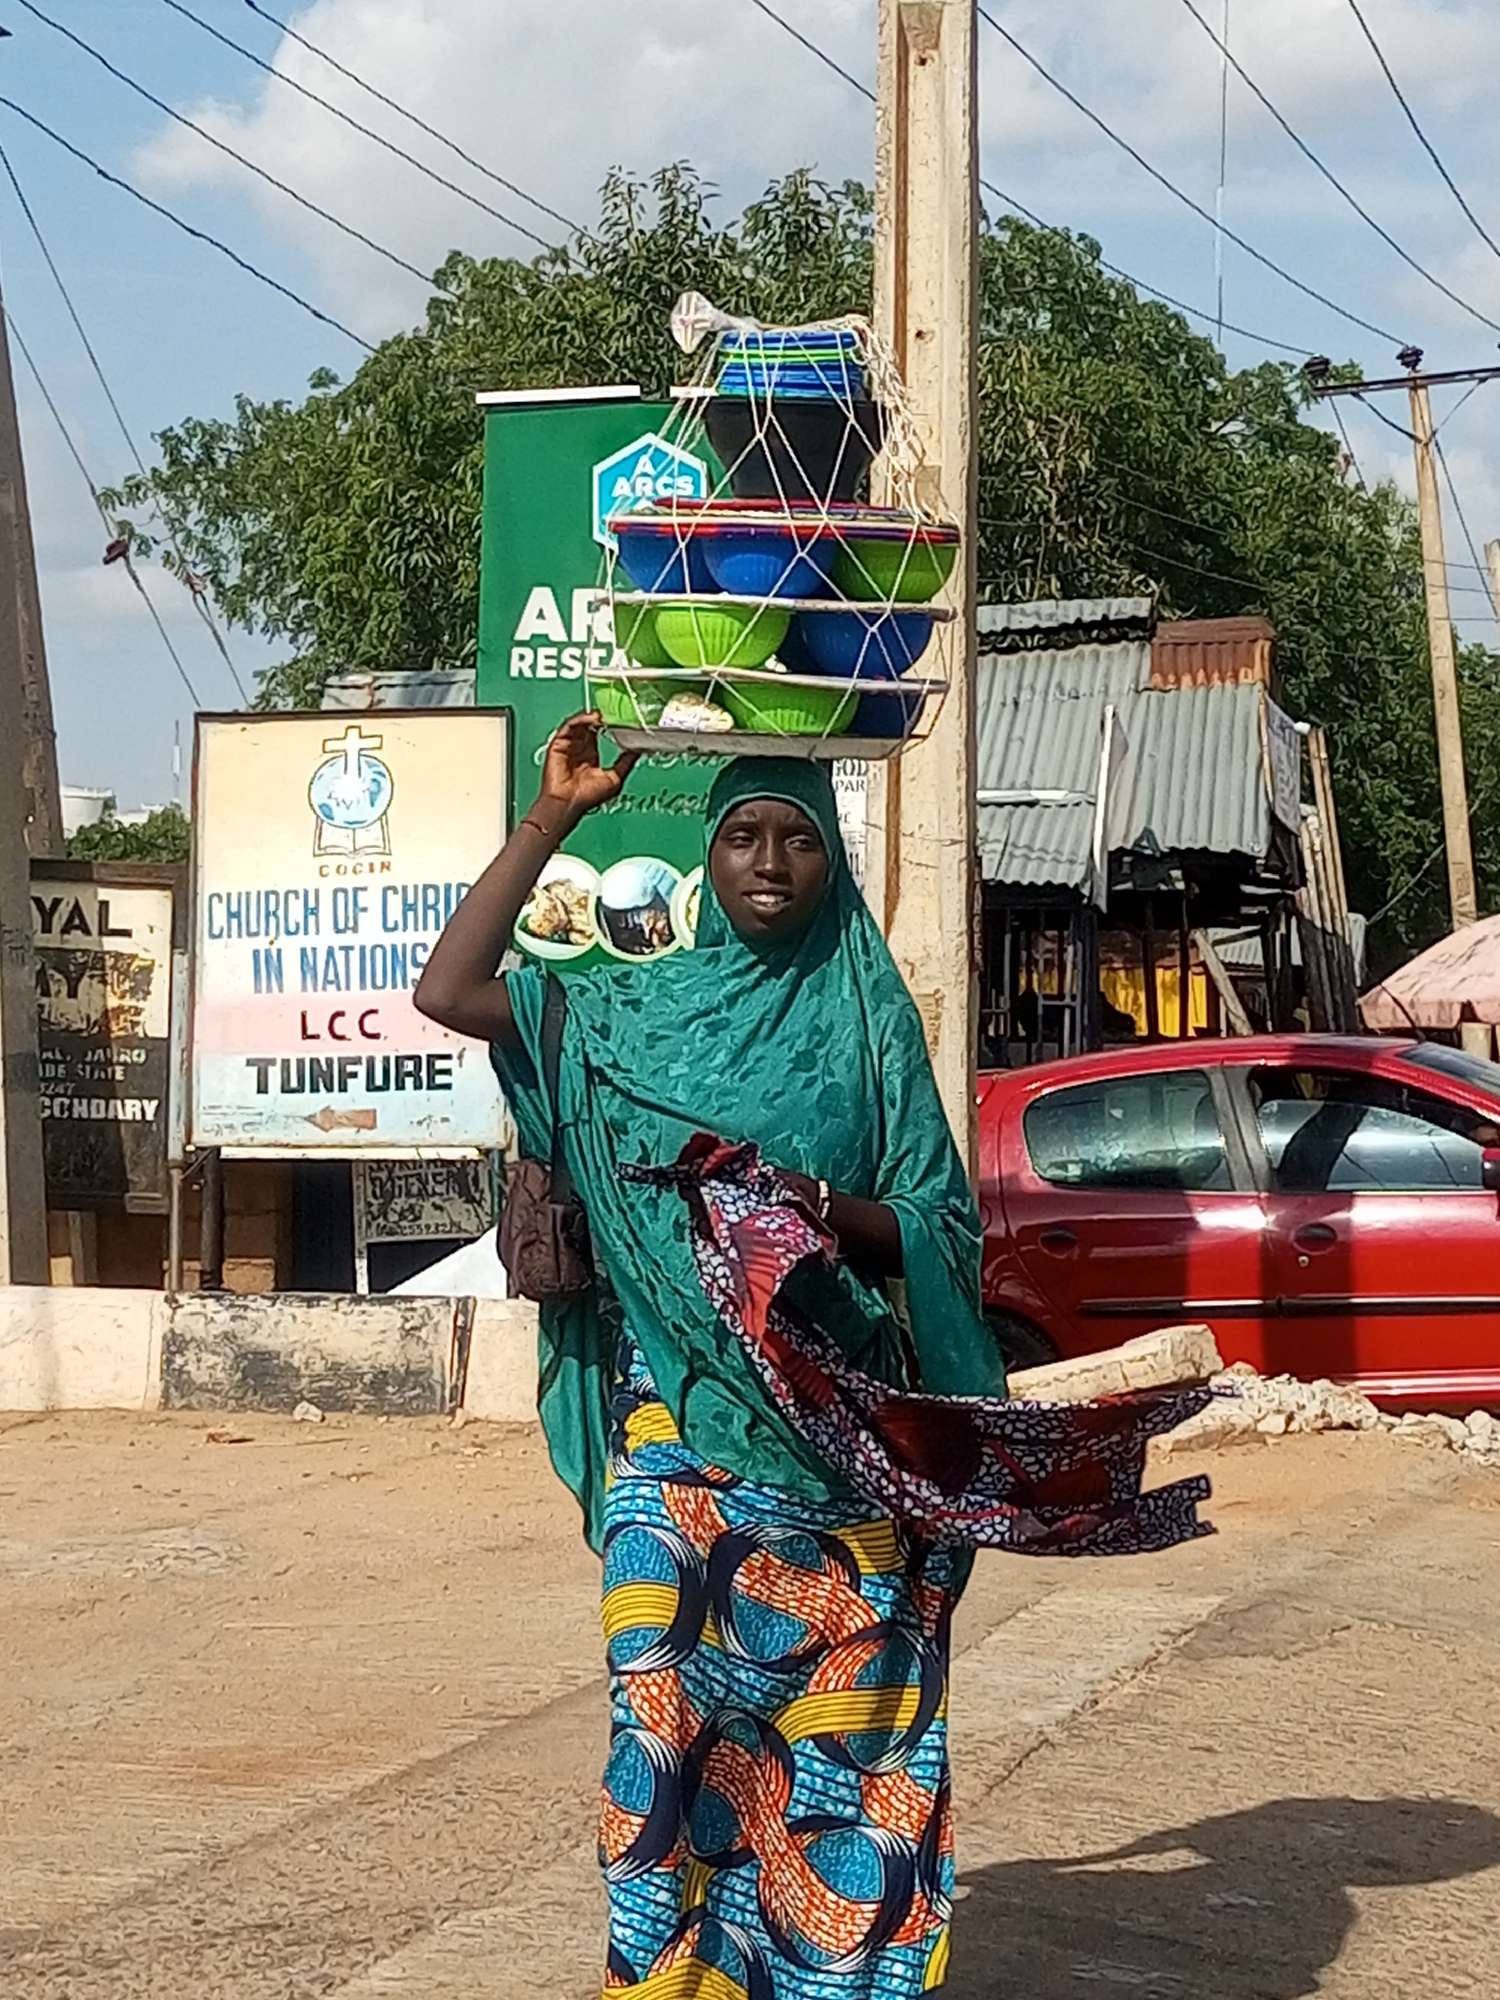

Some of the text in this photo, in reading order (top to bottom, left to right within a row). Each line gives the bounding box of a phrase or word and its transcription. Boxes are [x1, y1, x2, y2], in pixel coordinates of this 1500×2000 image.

[610, 475, 695, 498] ARCS
[30, 896, 132, 938] YAL
[207, 888, 320, 940] CHURCH
[332, 886, 368, 934] OF
[252, 942, 429, 994] IN NATIONS
[245, 1053, 454, 1094] TUNFURE
